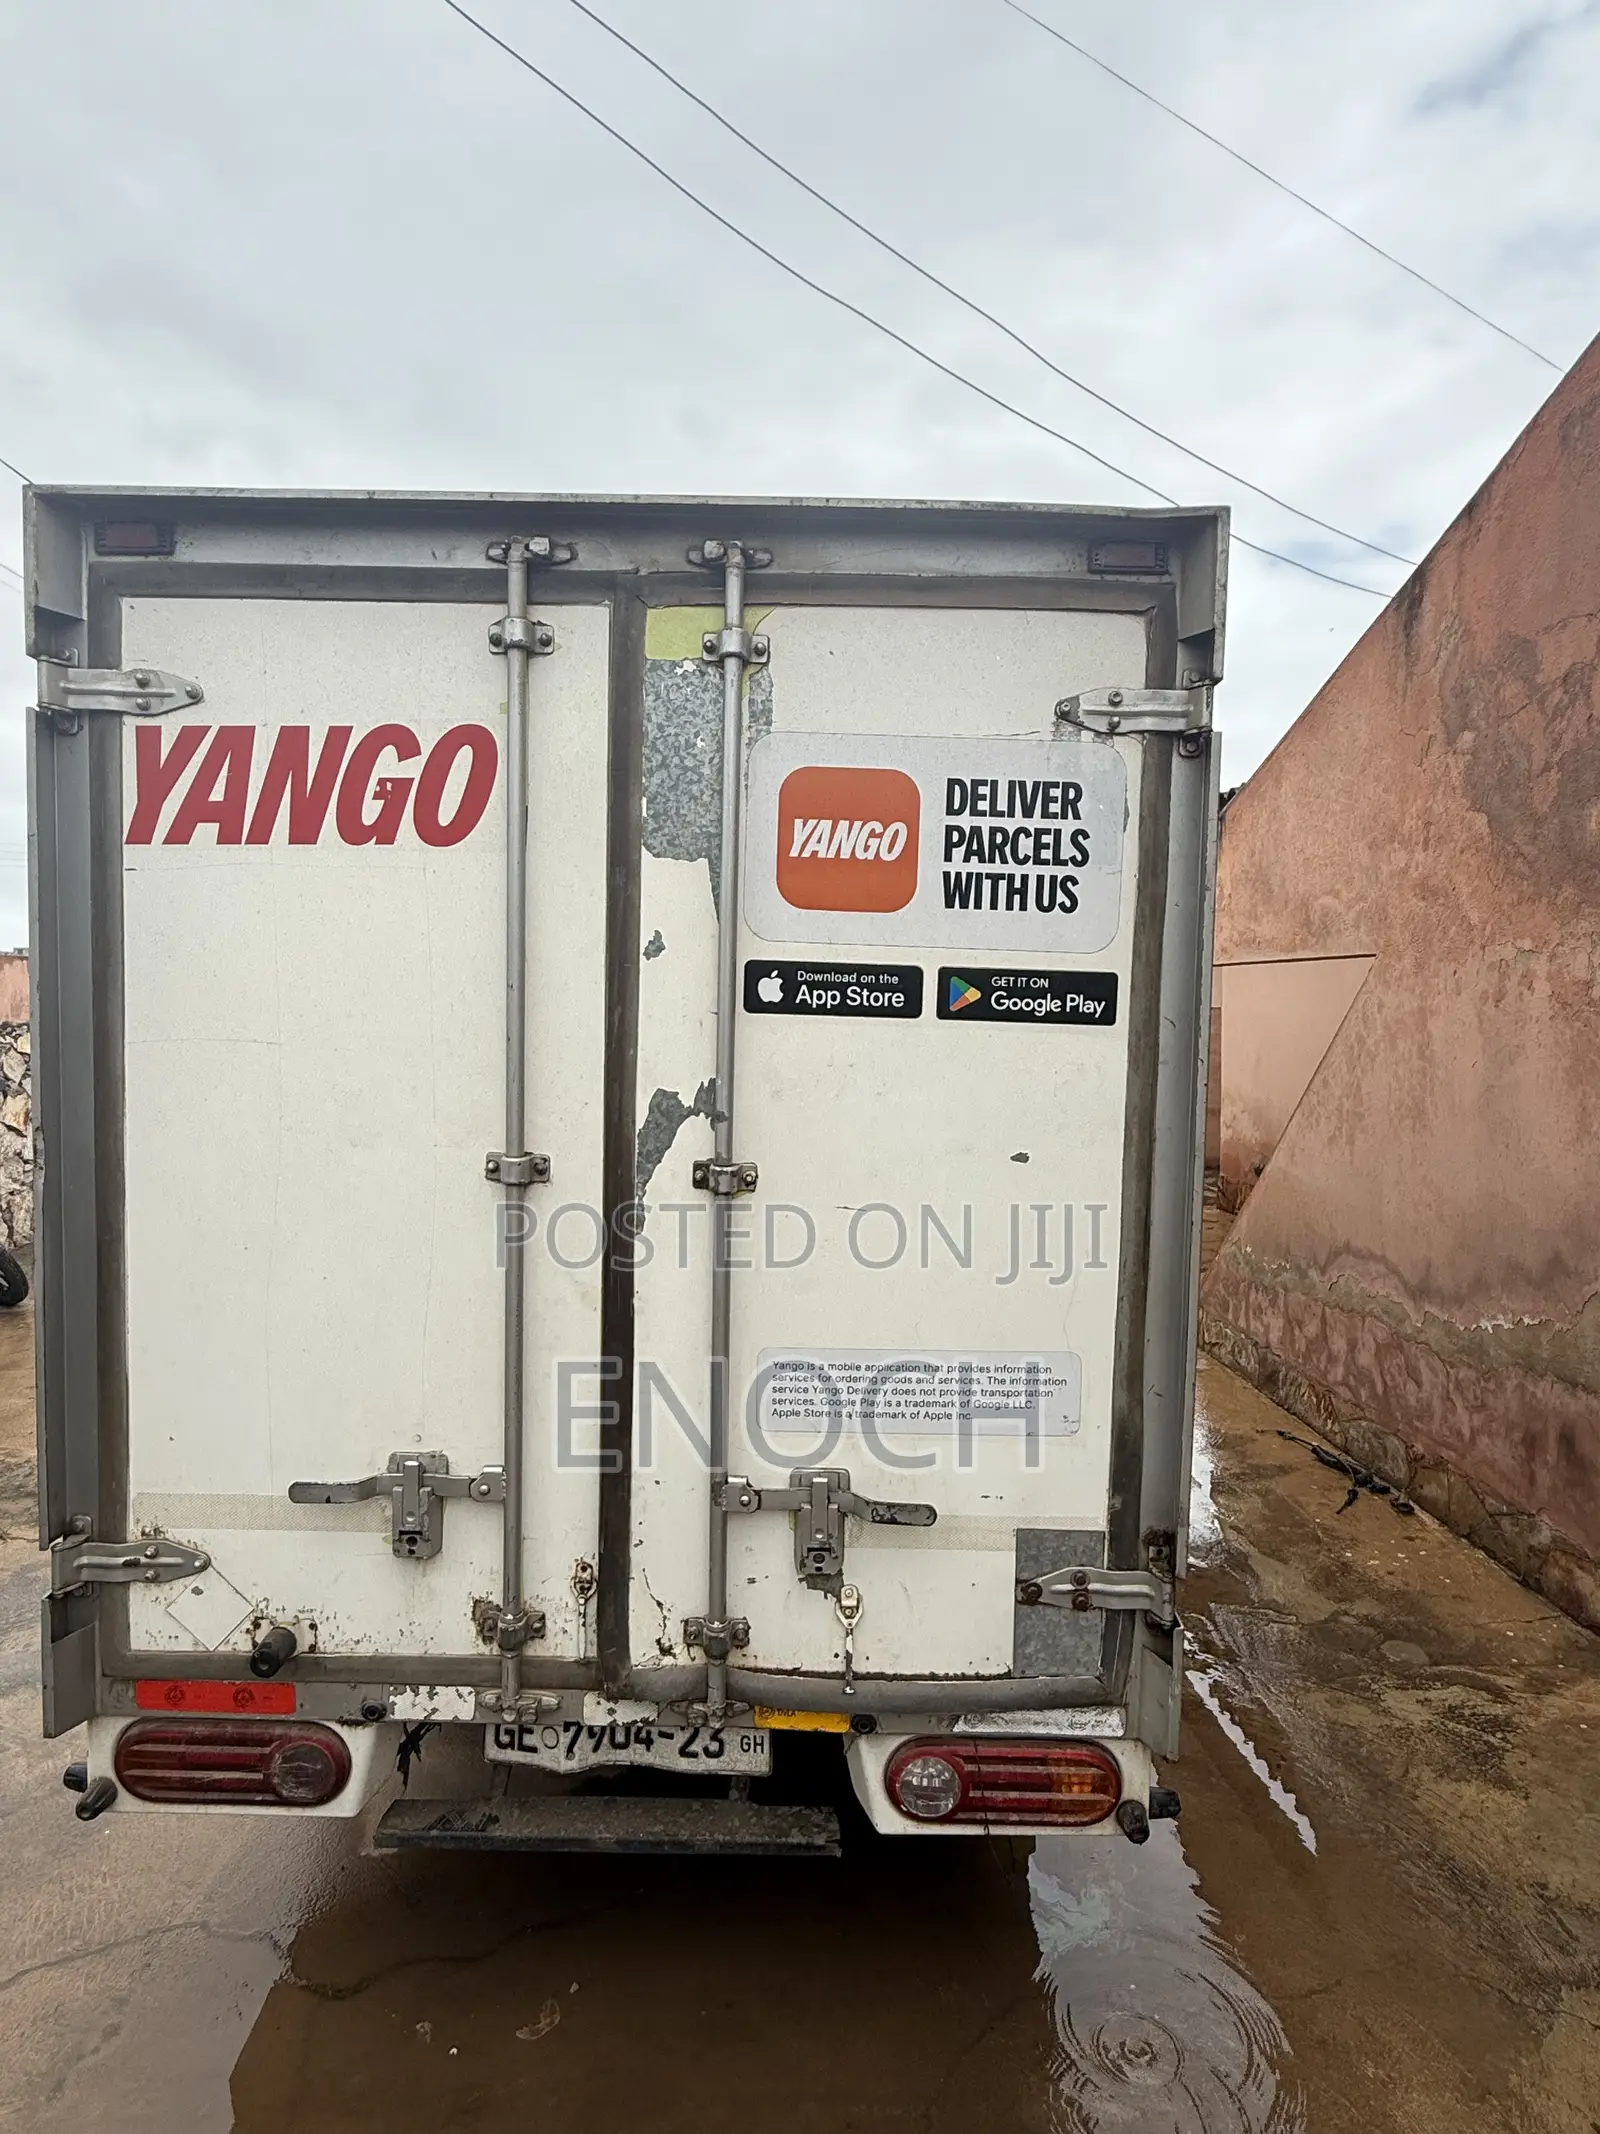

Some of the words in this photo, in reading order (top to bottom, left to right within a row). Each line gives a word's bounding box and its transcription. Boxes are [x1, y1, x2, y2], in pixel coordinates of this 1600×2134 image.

[124, 723, 498, 847] YANGO
[945, 777, 1083, 821] DELIVER
[788, 818, 908, 861] YANGO
[943, 824, 1091, 868] PARCELS
[942, 871, 1028, 913] WITH
[1034, 873, 1080, 914] US
[797, 971, 857, 983] Download
[860, 974, 876, 984] on
[879, 973, 899, 984] the
[991, 976, 1015, 987] GET
[1017, 977, 1028, 988] IT
[1030, 977, 1049, 988] ON
[795, 984, 841, 1009] App
[846, 985, 905, 1008] Store
[990, 991, 1062, 1017] Google
[1066, 994, 1106, 1018] Play
[772, 1372, 815, 1383] services
[818, 1373, 832, 1383] for
[834, 1374, 878, 1385] ordering
[880, 1375, 913, 1386] goods
[915, 1376, 935, 1385] and
[938, 1376, 984, 1385] services.
[987, 1376, 1007, 1385] The
[1009, 1376, 1068, 1387] information
[773, 1361, 805, 1373] Yango
[807, 1361, 817, 1371] is
[827, 1362, 862, 1372] mobile
[864, 1363, 921, 1374] application
[923, 1364, 944, 1373] that
[946, 1364, 991, 1375] provides
[993, 1364, 1052, 1374] information
[771, 1396, 818, 1406] services.
[820, 1397, 857, 1409] Google
[860, 1398, 881, 1409] Play
[883, 1399, 893, 1408] is
[904, 1399, 957, 1409] trademark
[960, 1399, 971, 1409] of
[973, 1400, 1010, 1411] Google
[772, 1385, 809, 1394] service
[812, 1385, 844, 1397] Yango
[846, 1386, 889, 1398] Delivery
[891, 1387, 917, 1396] does
[919, 1388, 936, 1397] not
[939, 1388, 978, 1399] provide
[980, 1388, 1054, 1399] transportation
[771, 1408, 801, 1419] Apple
[803, 1408, 831, 1418] Store
[834, 1409, 843, 1418] is
[855, 1409, 907, 1419] trademark
[909, 1409, 922, 1419] of
[923, 1411, 953, 1421] Apple
[495, 1724, 538, 1753] GE
[563, 1720, 725, 1760] 7904-23
[739, 1735, 765, 1754] GH
